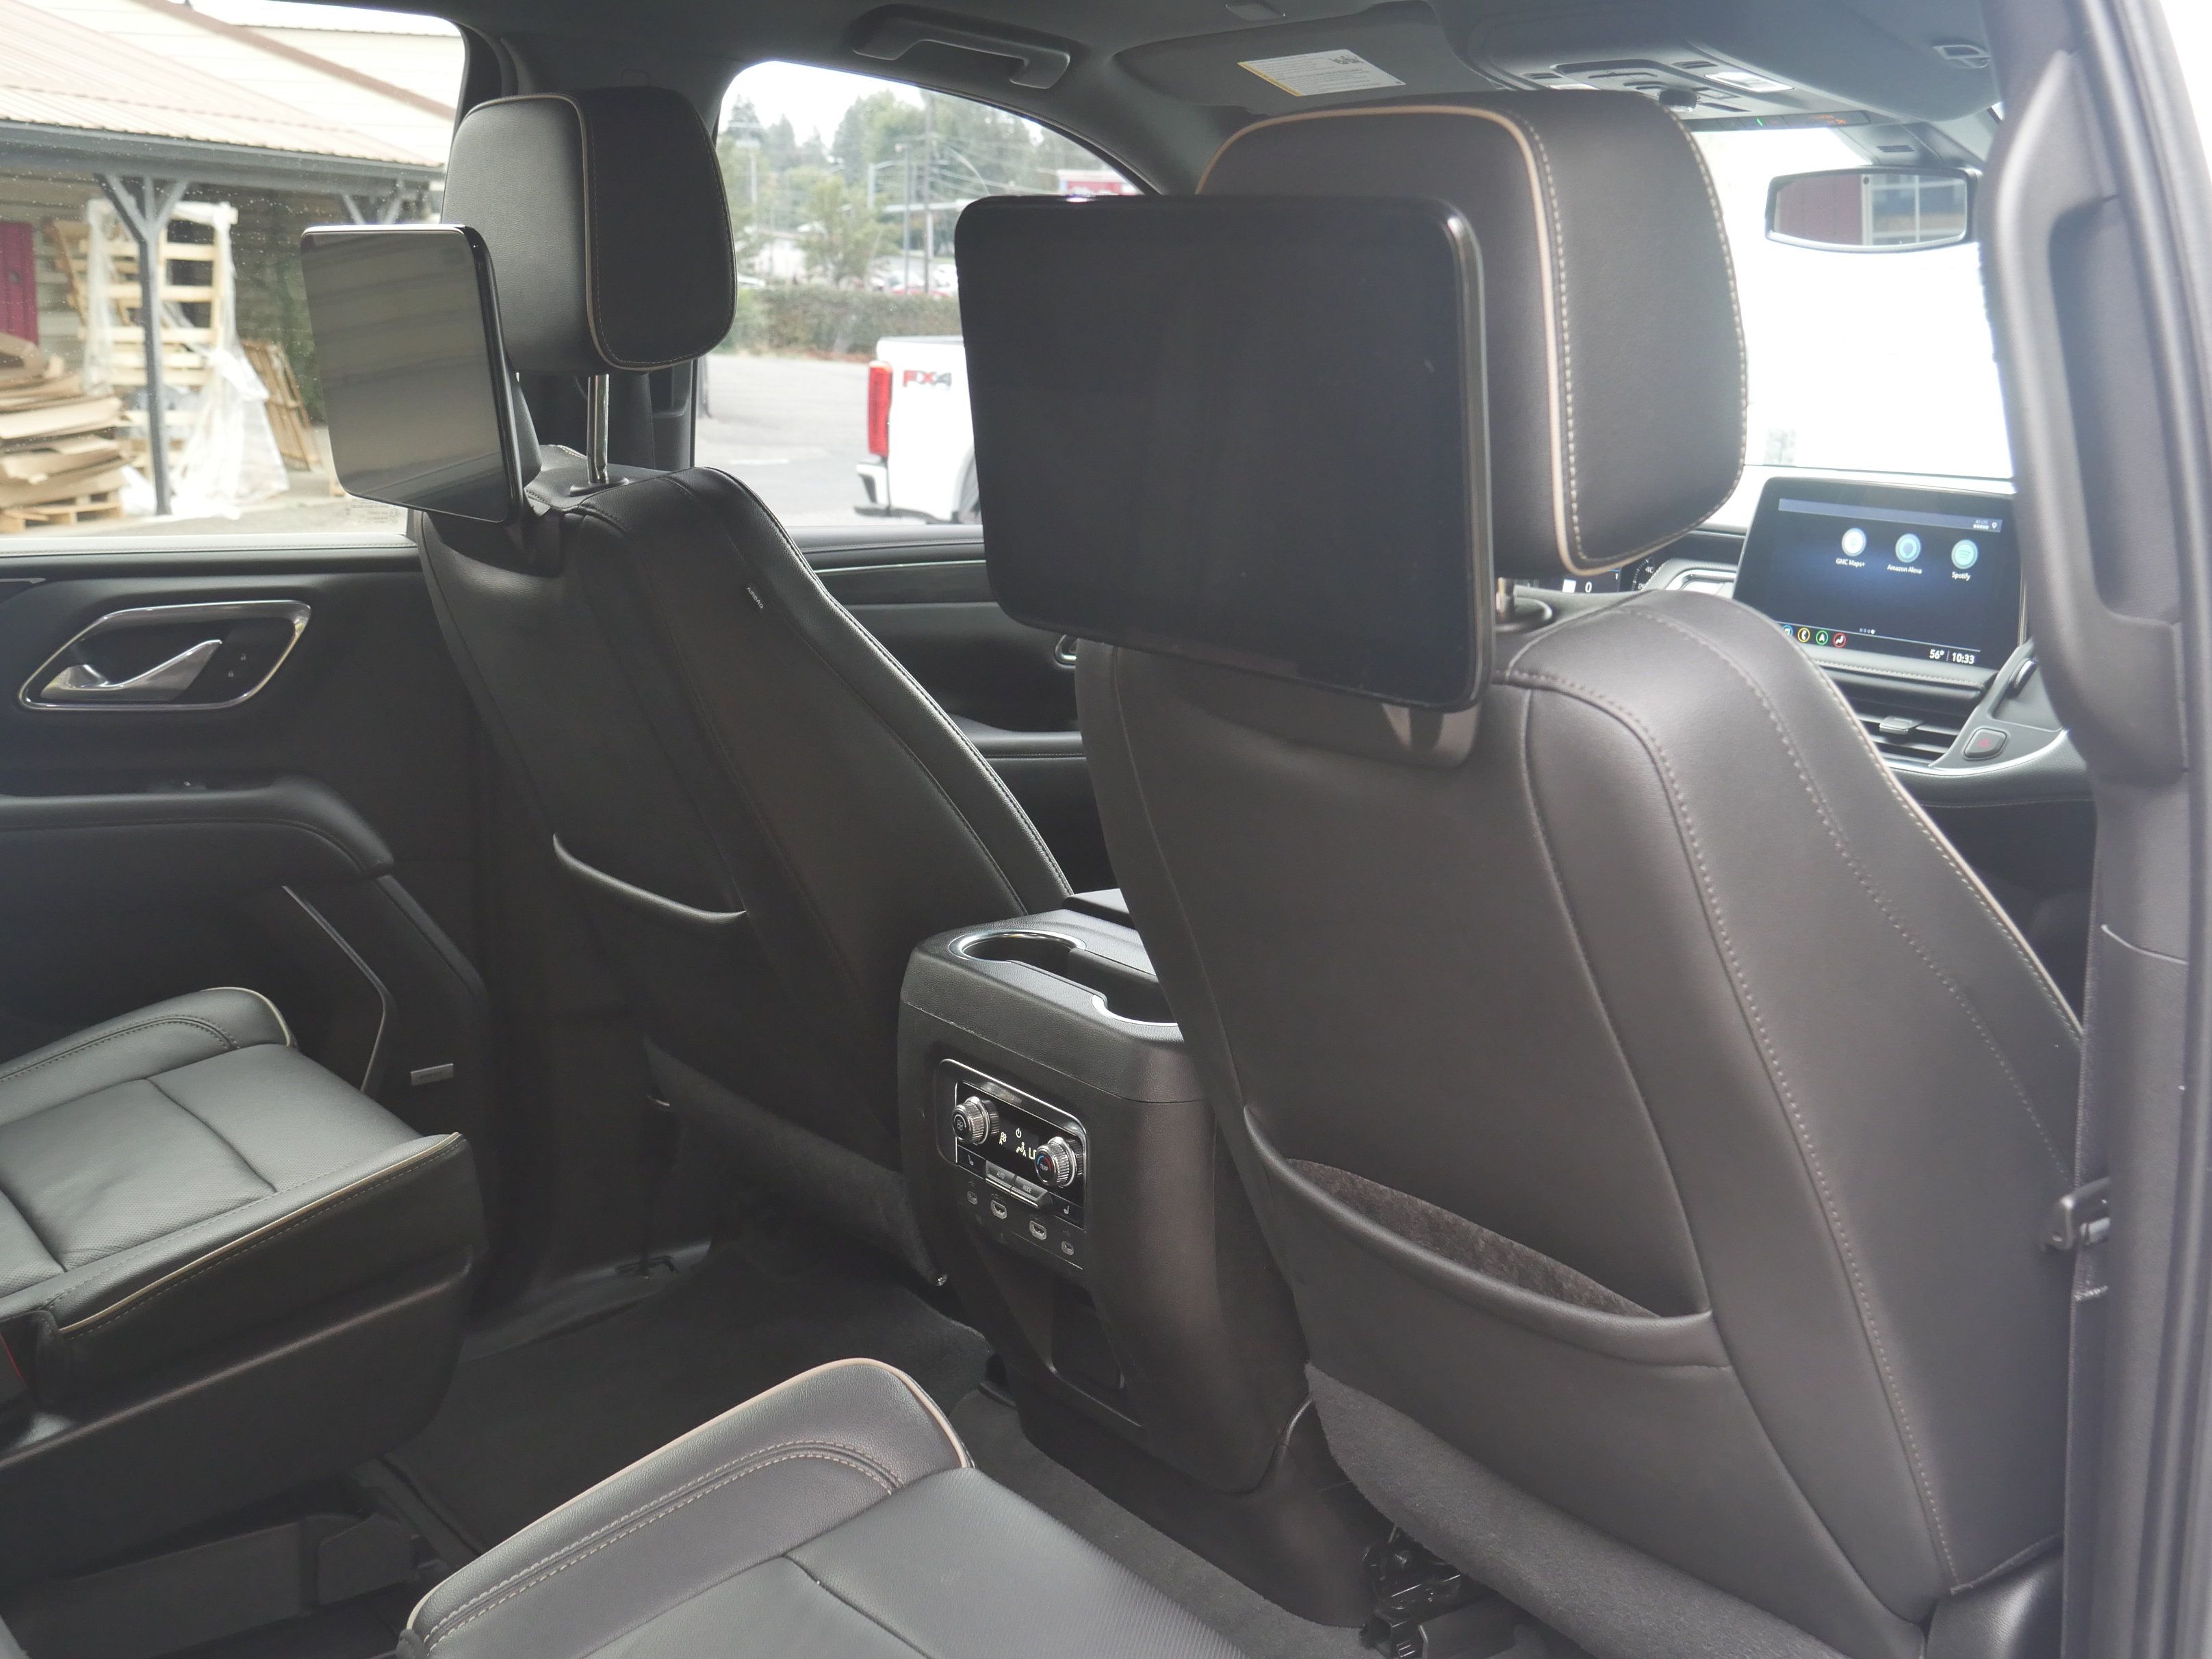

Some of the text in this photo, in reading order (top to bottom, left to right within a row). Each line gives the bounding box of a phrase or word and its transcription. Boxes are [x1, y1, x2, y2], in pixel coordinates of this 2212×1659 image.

[902, 370, 952, 387] FX4
[1849, 559, 1865, 568] Maps+
[1887, 564, 1907, 572] Amazon
[1951, 571, 1970, 582] Spotify
[746, 587, 764, 609] AIRBAG
[1952, 652, 1975, 665] 10:33
